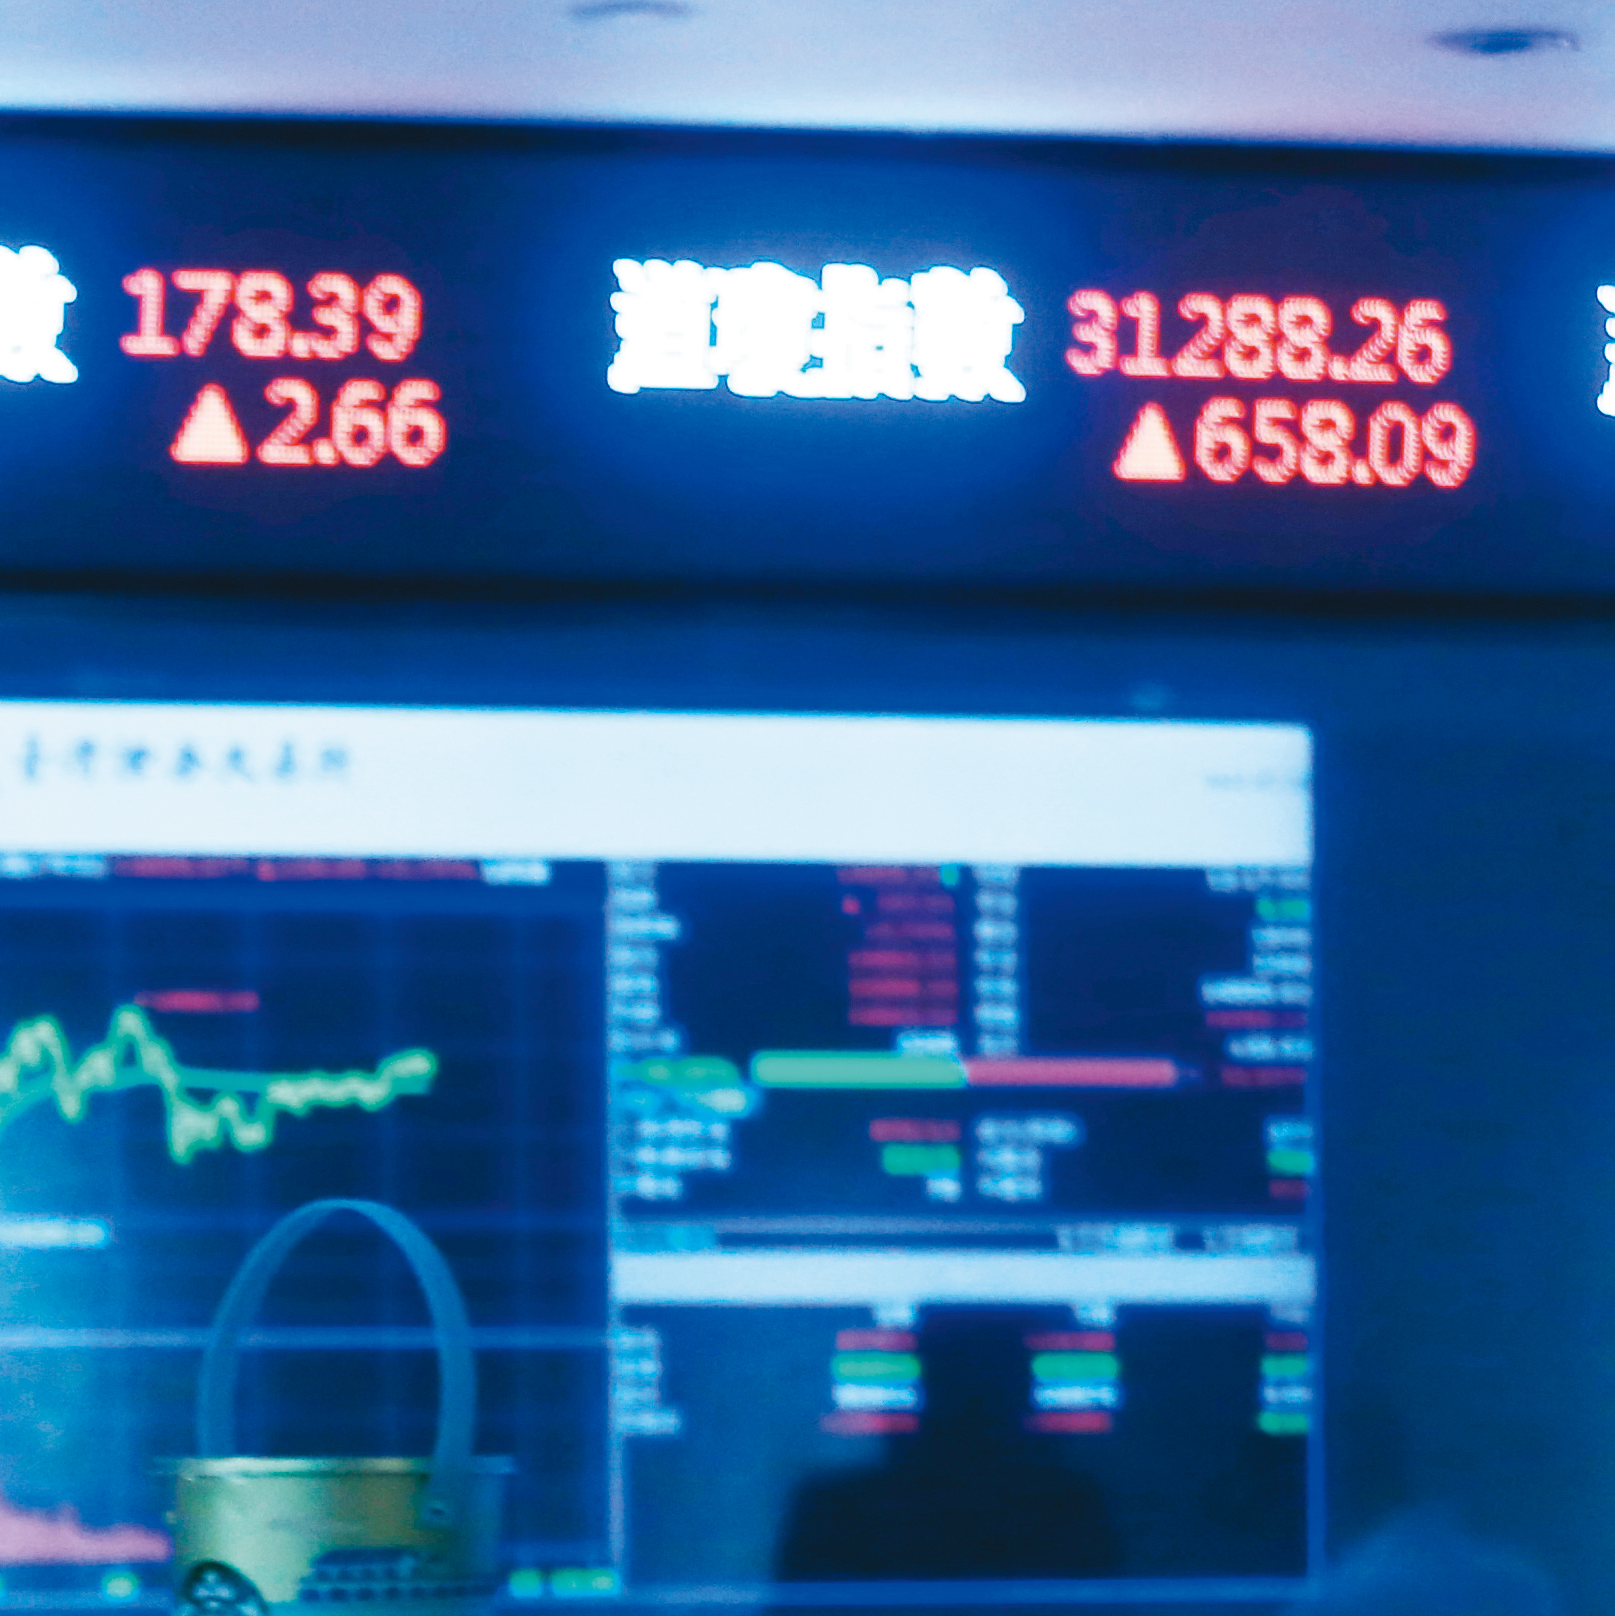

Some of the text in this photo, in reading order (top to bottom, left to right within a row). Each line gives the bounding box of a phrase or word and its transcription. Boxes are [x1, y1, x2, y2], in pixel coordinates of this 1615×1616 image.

[119, 267, 423, 363] 178.39
[1065, 289, 1454, 386] 31288.26
[254, 376, 448, 468] 2.66
[1191, 394, 1478, 489] 658.09
